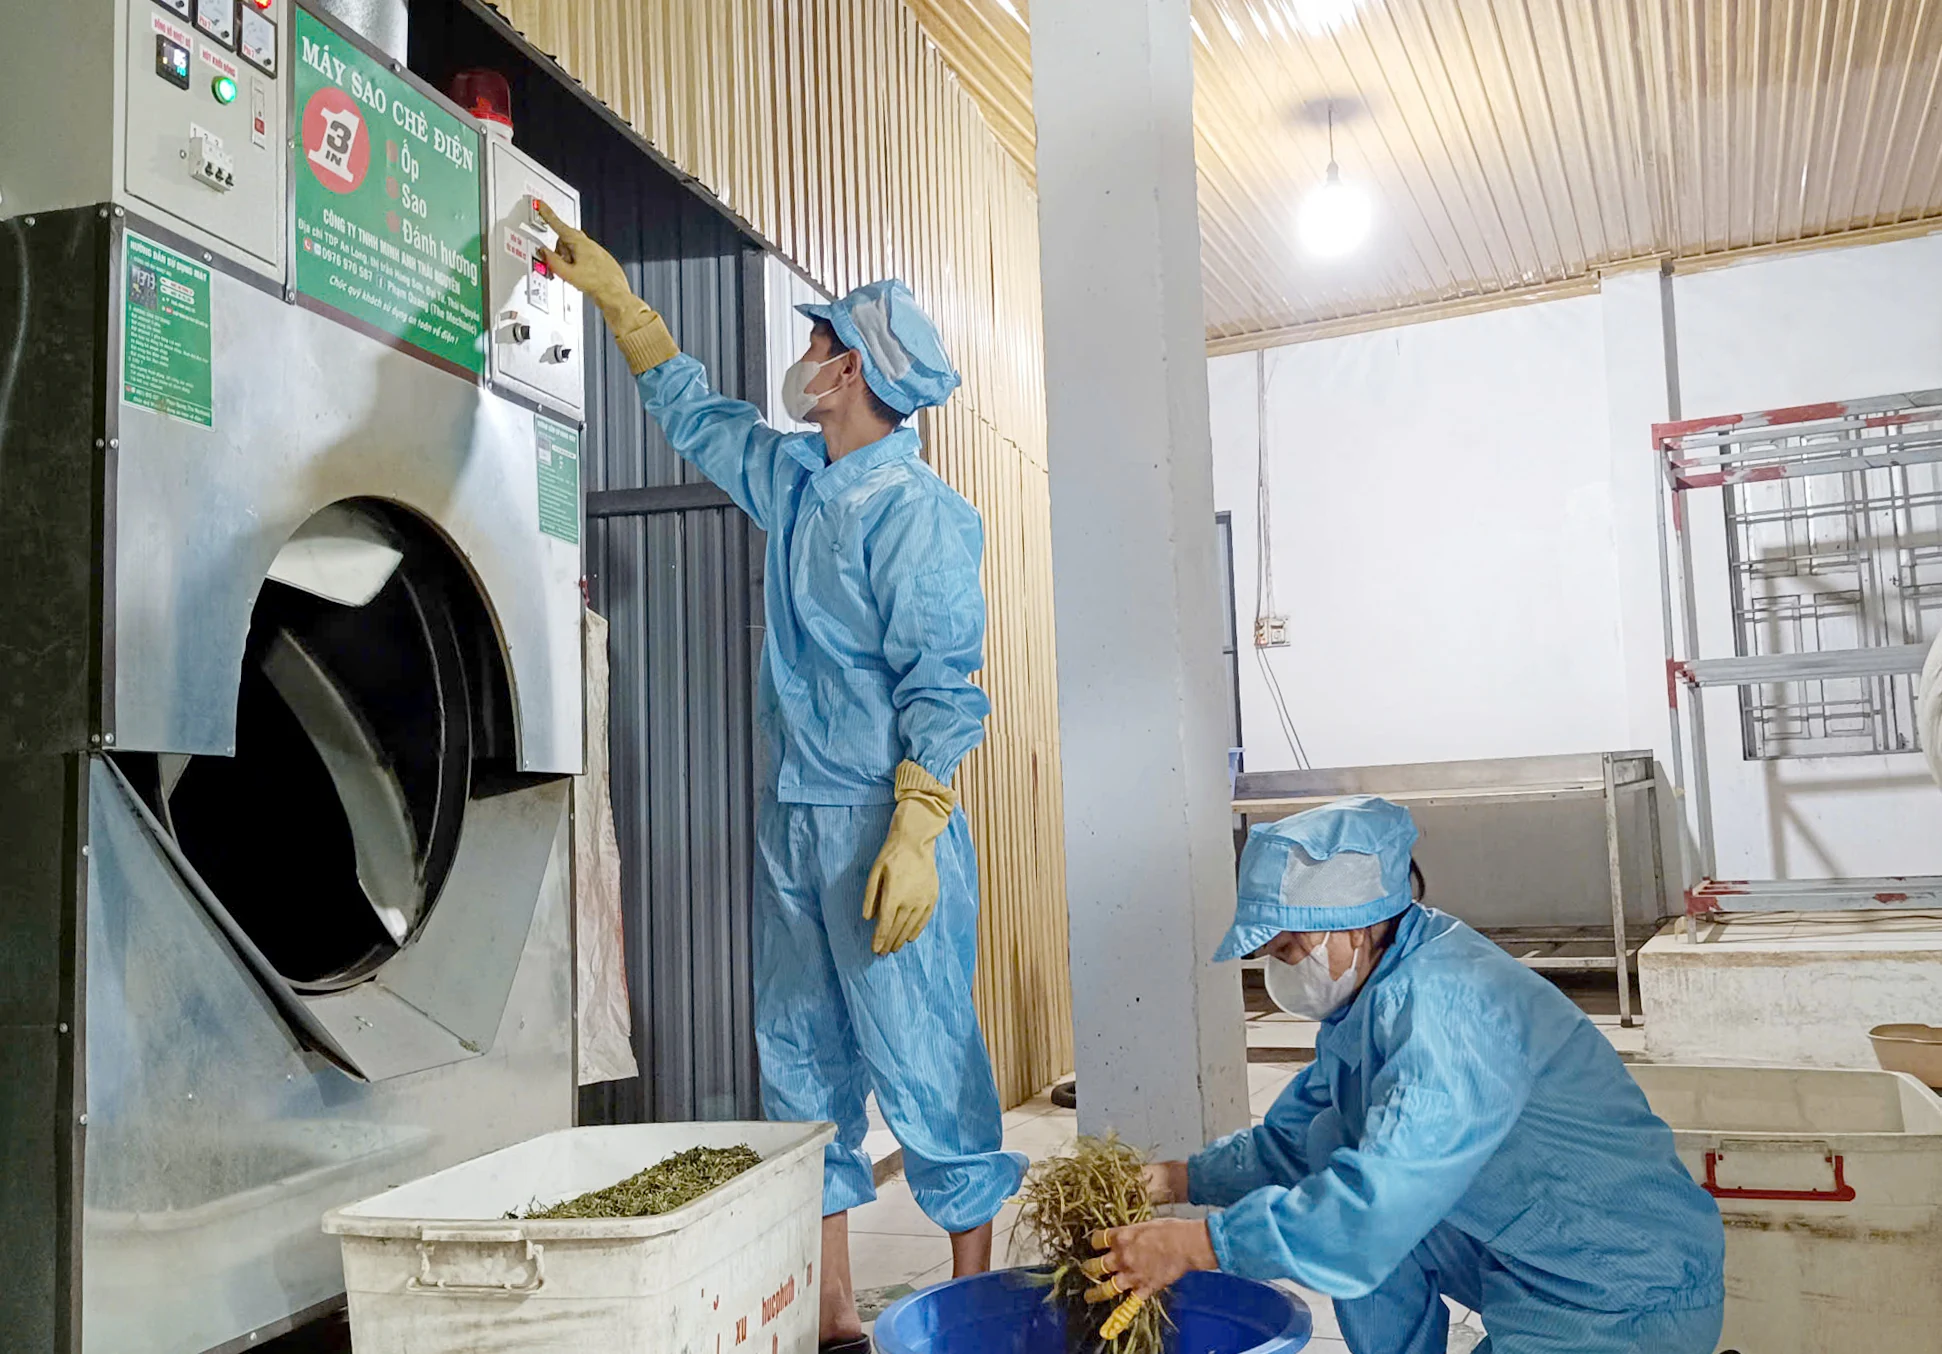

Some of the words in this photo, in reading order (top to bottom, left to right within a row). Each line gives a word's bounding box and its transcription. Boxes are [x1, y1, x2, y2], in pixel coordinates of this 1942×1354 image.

[302, 36, 346, 86] MÁY
[351, 71, 387, 114] SAO
[392, 100, 428, 143] CHÈ
[433, 127, 474, 173] ĐIỆN
[325, 151, 342, 166] IN
[327, 120, 352, 154] 3
[401, 138, 419, 183] Ốp
[402, 184, 428, 219] Sao
[323, 208, 346, 234] CÔNG
[347, 221, 358, 239] TY
[358, 227, 379, 251] TNHH
[380, 239, 400, 263] MINH
[401, 251, 417, 272] ANH
[324, 231, 339, 247] TDP
[340, 240, 350, 254] An
[402, 219, 437, 259] Đánh
[441, 240, 478, 287] hương
[322, 246, 341, 267] 0976
[430, 303, 445, 319] (The
